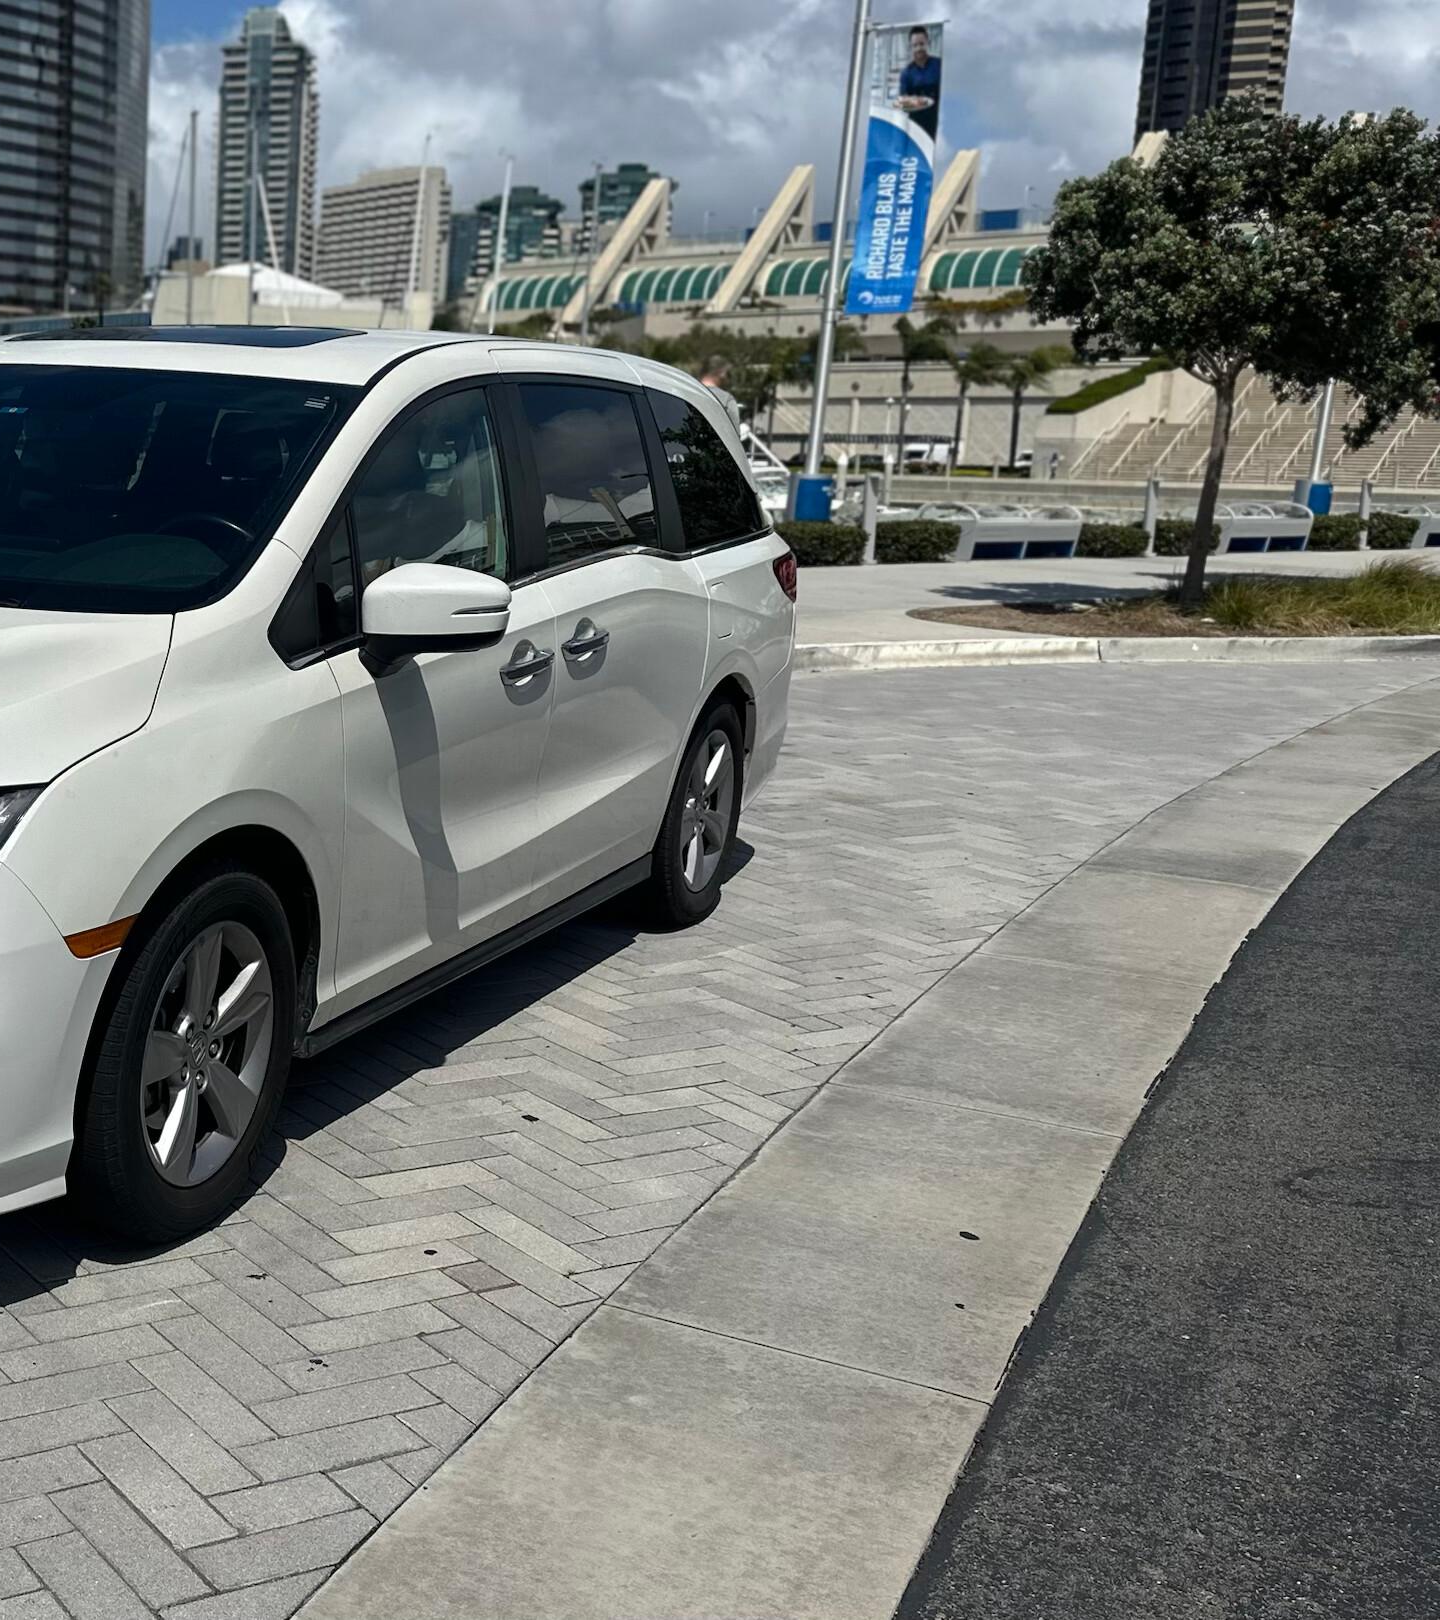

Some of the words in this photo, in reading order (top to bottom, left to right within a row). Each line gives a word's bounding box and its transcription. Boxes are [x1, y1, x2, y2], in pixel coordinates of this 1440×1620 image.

[875, 173, 897, 213] BLAIS
[898, 156, 918, 204] MAGIC
[894, 207, 912, 233] THE
[865, 218, 891, 280] RICHARD
[886, 236, 908, 279] TASTE
